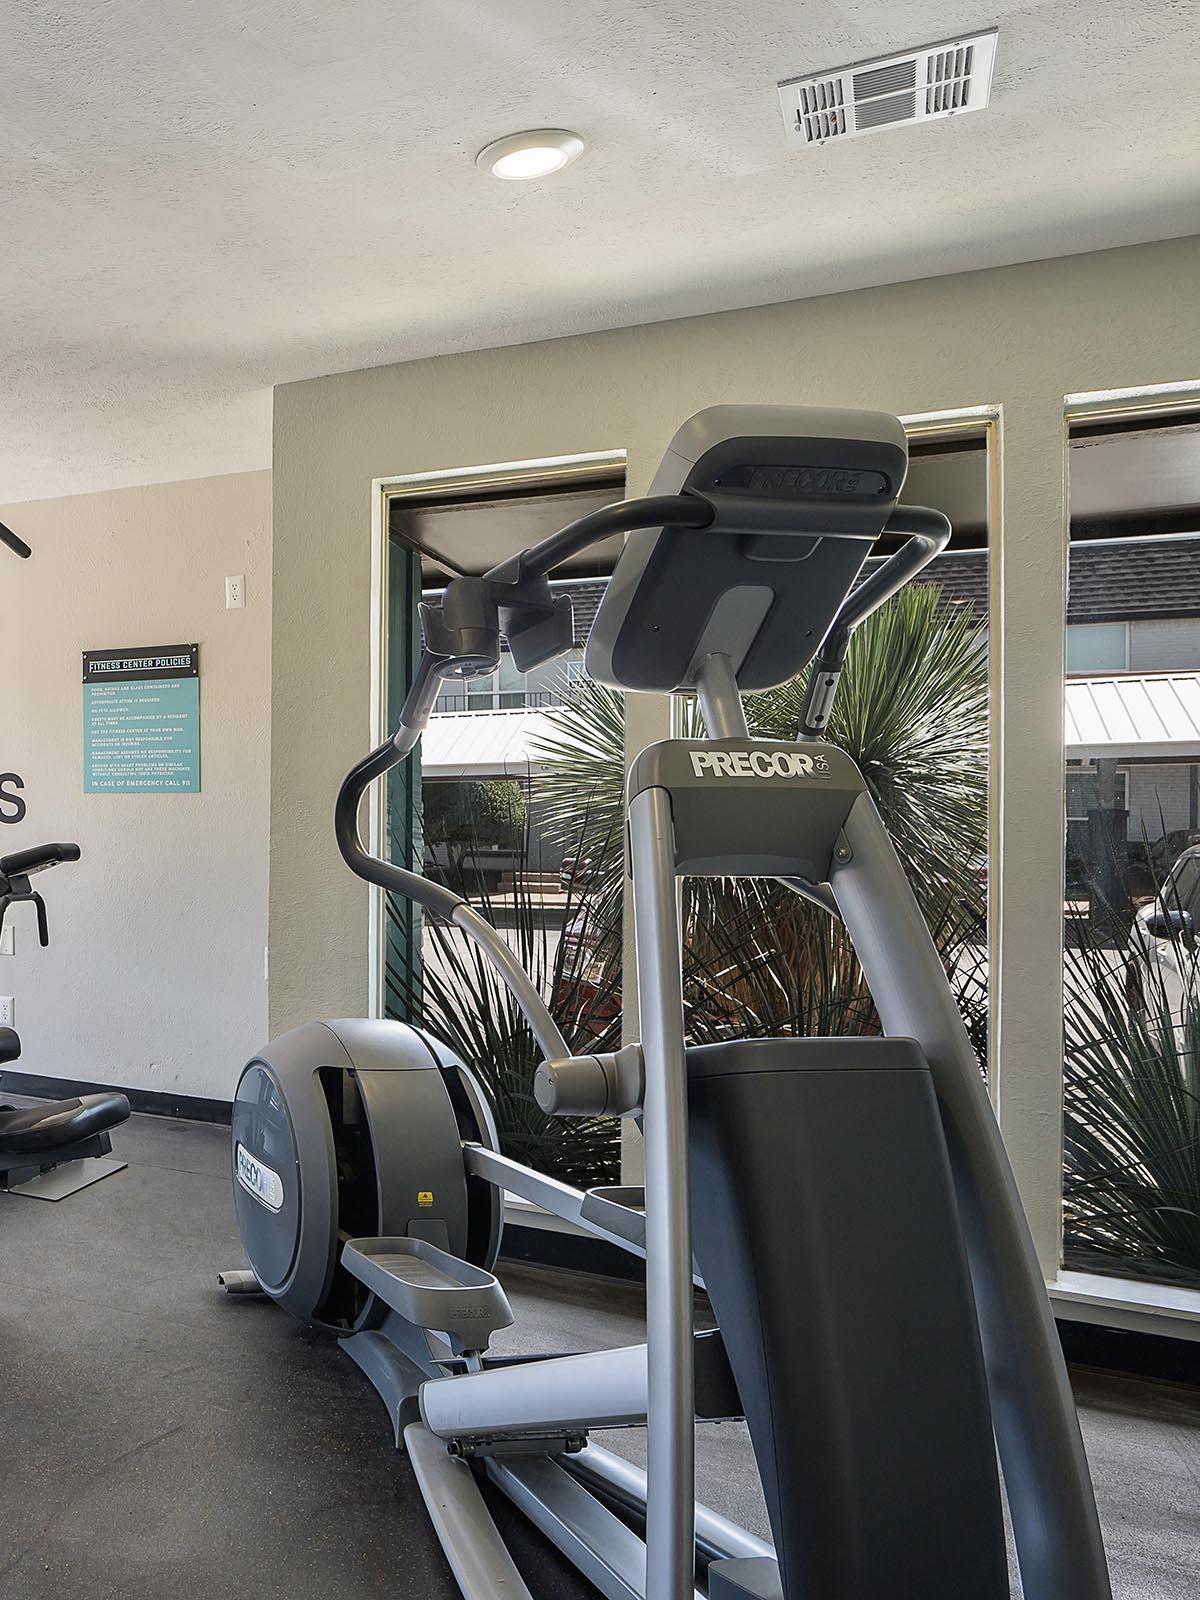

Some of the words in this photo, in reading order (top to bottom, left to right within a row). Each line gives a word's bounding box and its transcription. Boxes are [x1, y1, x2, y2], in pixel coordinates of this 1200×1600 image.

[89, 661, 121, 673] FITNESS
[122, 659, 153, 669] CENTER
[155, 656, 191, 667] POLICIES
[689, 751, 817, 778] PRECOR
